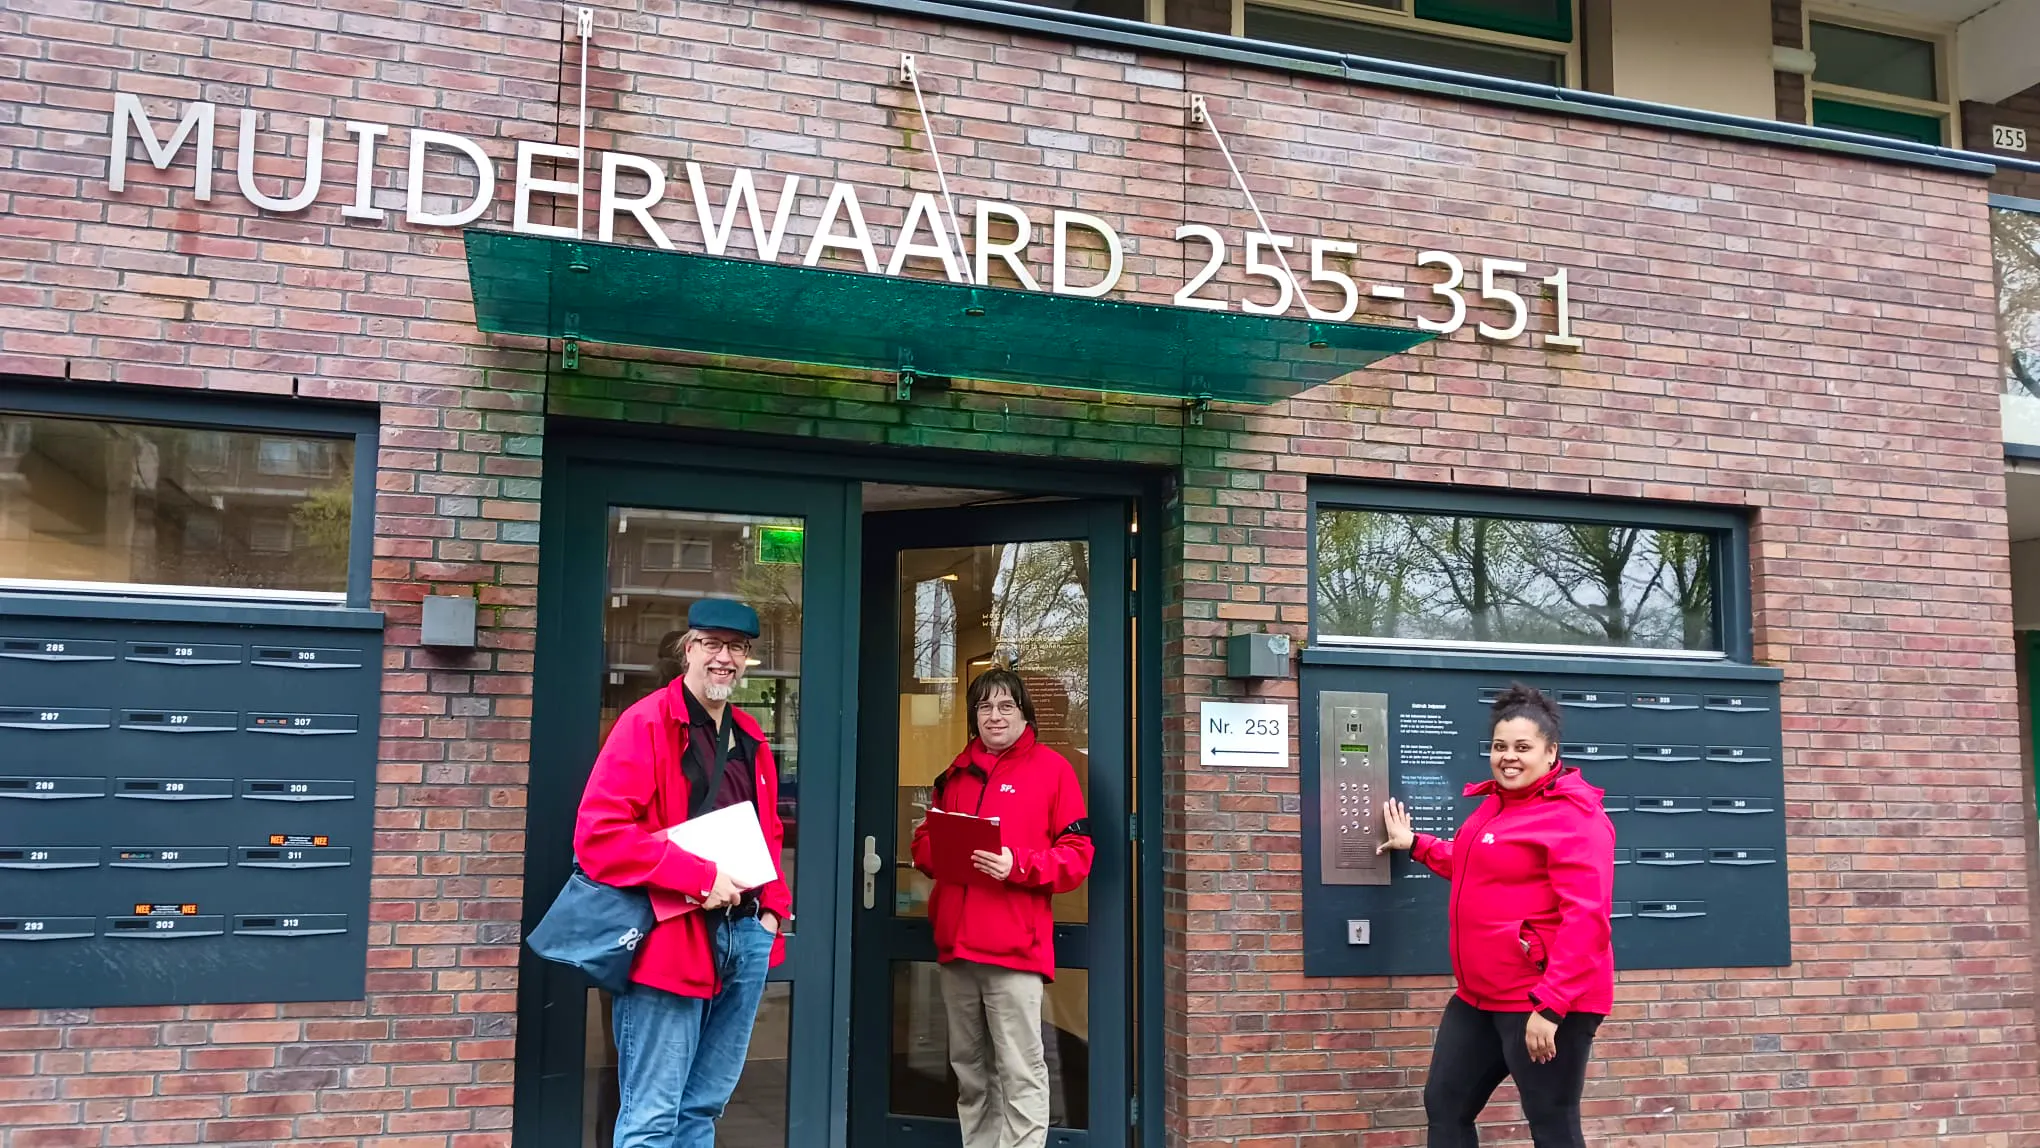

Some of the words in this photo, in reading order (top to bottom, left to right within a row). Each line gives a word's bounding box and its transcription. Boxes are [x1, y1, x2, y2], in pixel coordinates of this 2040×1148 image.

[1995, 128, 2024, 148] 255
[108, 91, 1125, 298] MUIDERWAARD
[1173, 223, 1582, 348] 255-351
[1210, 717, 1233, 734] Nr.
[1245, 718, 1280, 736] 253
